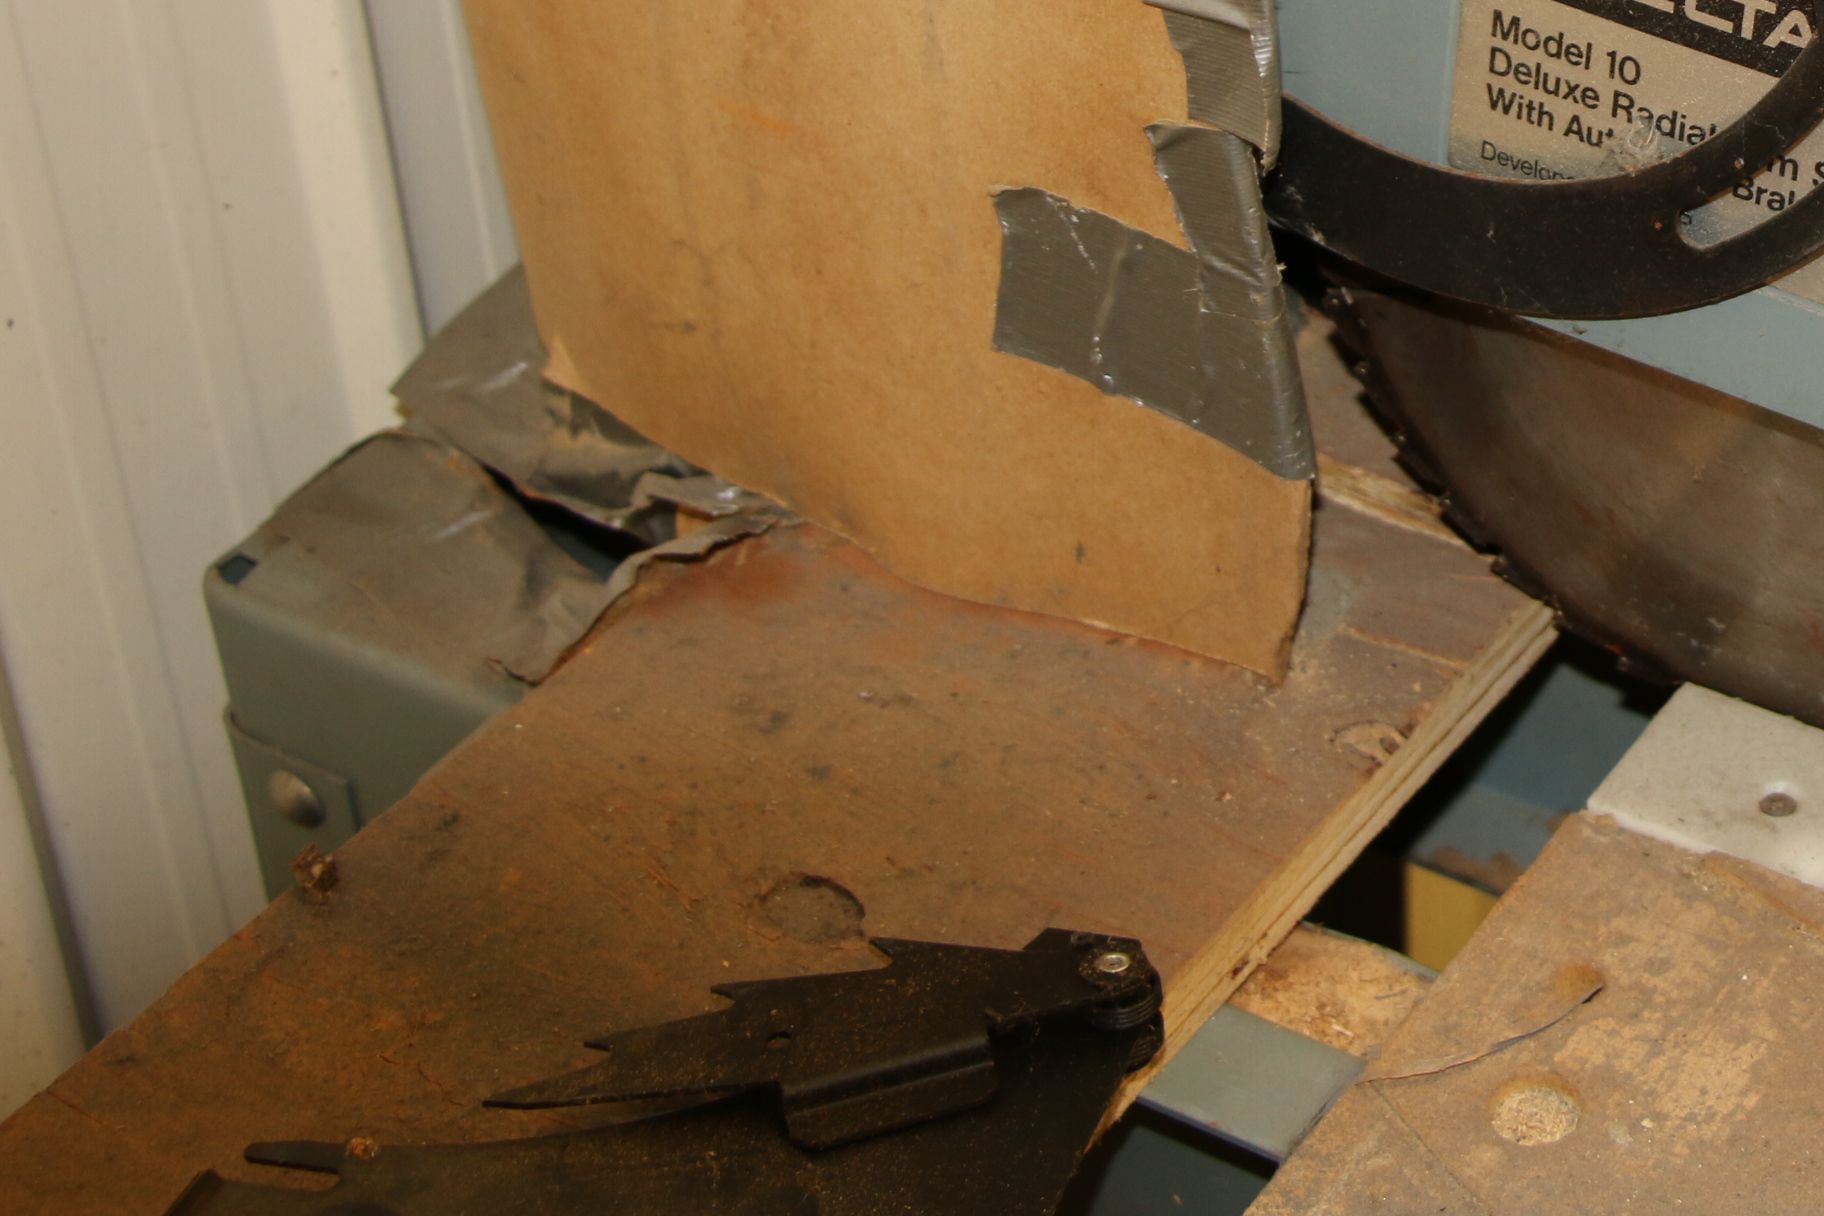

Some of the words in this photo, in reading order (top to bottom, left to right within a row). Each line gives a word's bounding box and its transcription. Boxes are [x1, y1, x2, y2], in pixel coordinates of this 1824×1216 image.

[1489, 46, 1600, 109] Deluxe
[1491, 9, 1593, 70] Model
[1606, 50, 1641, 85] 10
[1487, 83, 1554, 131] With
